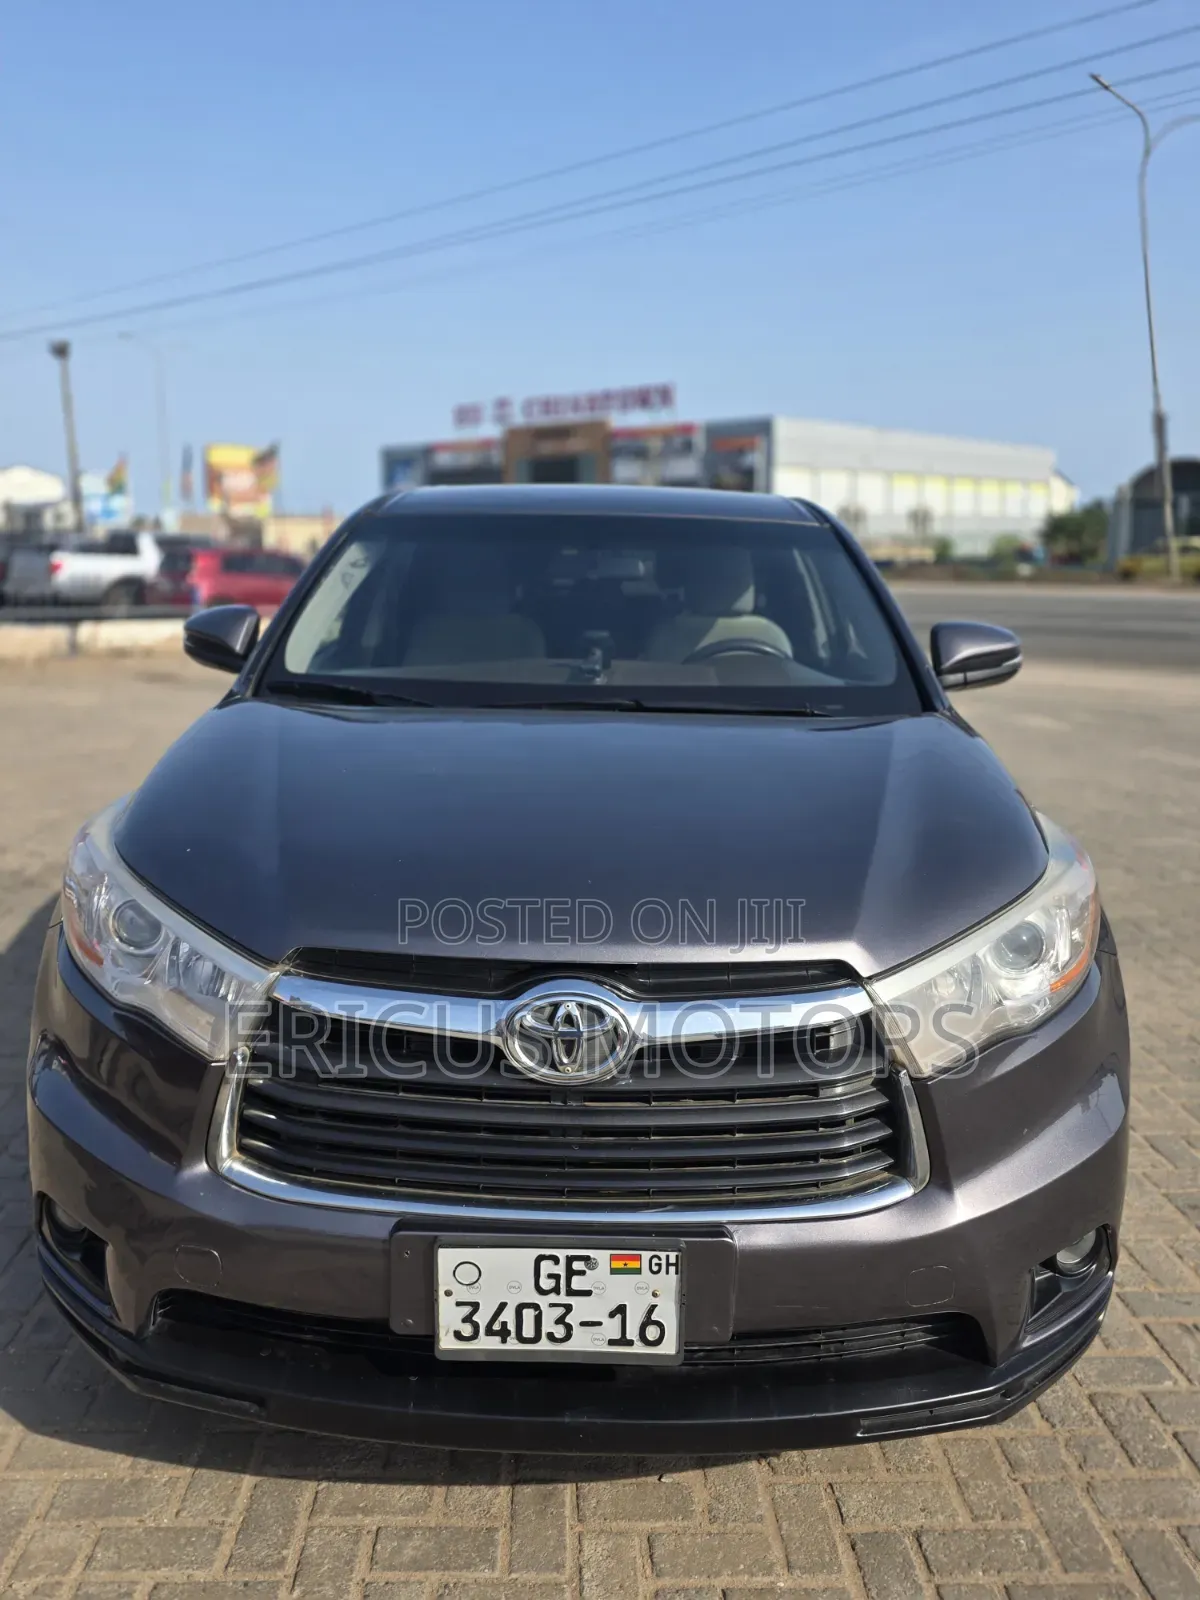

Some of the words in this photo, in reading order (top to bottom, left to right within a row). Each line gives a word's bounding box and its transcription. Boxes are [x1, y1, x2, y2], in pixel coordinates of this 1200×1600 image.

[534, 1254, 593, 1296] GE
[648, 1254, 680, 1276] GH
[453, 1301, 666, 1347] 3403-16
